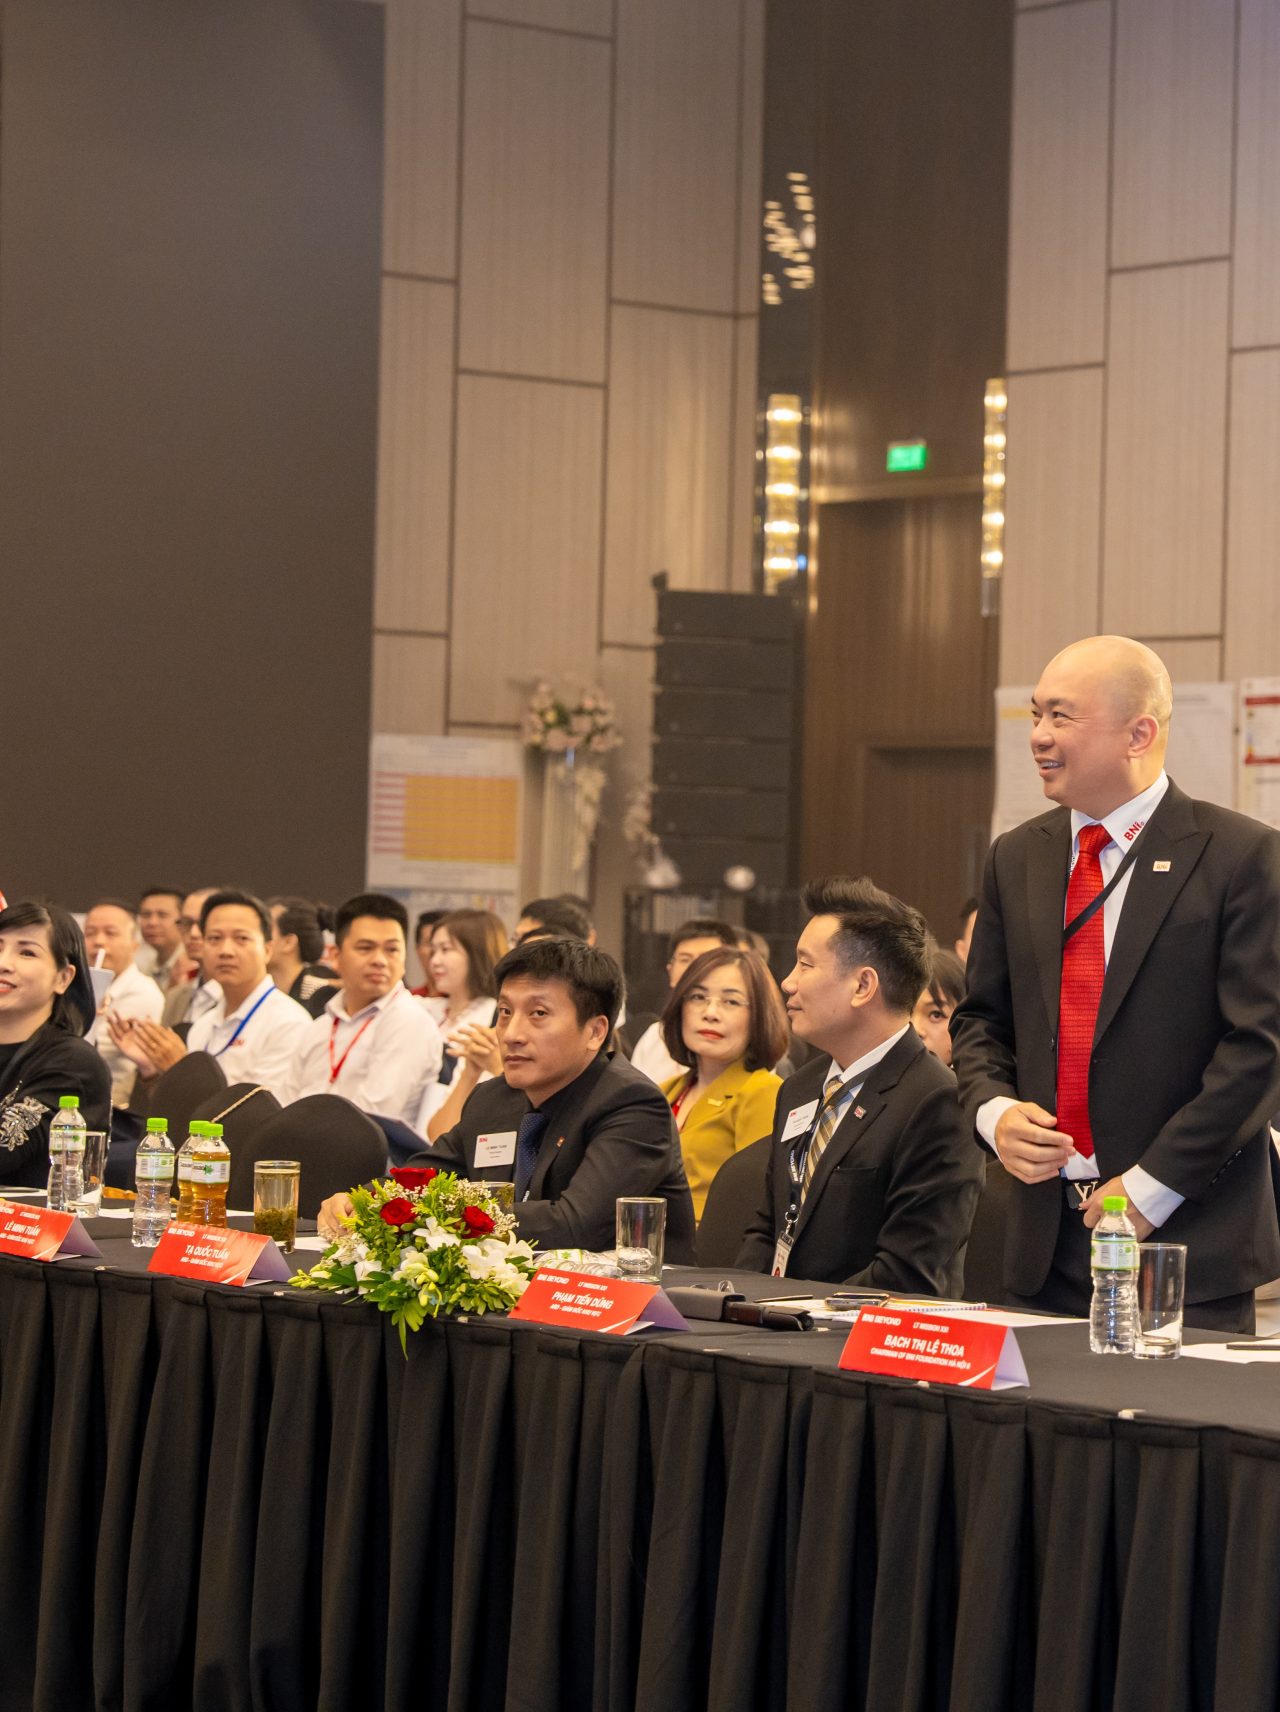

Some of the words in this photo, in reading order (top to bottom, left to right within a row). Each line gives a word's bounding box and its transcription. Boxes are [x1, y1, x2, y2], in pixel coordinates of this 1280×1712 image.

[551, 1291, 575, 1304] PHẠM
[874, 1315, 902, 1326] BEYOND
[884, 1334, 912, 1348] BẠCH
[912, 1338, 928, 1353] THỊ
[927, 1339, 941, 1354] LỆ
[940, 1342, 965, 1357] THOA
